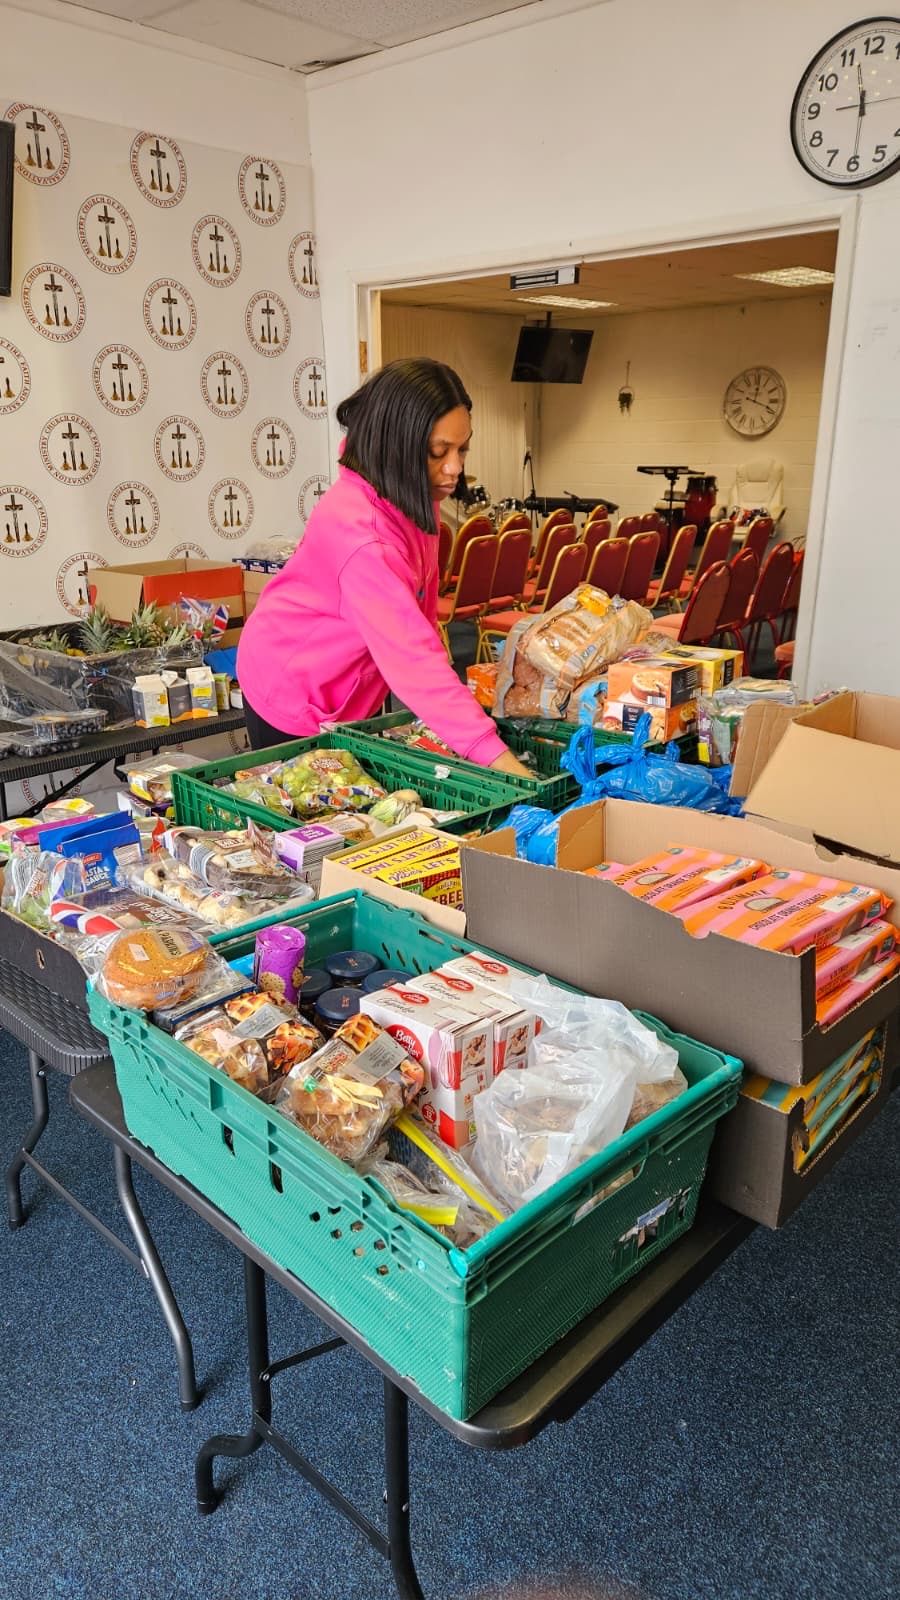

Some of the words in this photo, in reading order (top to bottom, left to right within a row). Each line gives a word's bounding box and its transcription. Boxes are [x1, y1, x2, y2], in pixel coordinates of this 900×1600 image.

[864, 36, 886, 56] 12
[841, 48, 856, 67] 11
[818, 73, 838, 92] 10
[808, 103, 820, 120] 9
[48, 112, 63, 129] FIRE
[61, 134, 69, 158] FAITH
[809, 131, 823, 147] 8
[826, 149, 839, 167] 7
[872, 145, 887, 162] 5
[59, 161, 68, 175] AND
[846, 155, 860, 172] 6
[17, 166, 60, 184] SALVATION
[26, 265, 51, 283] CHURCH
[64, 272, 79, 288] FIRE
[24, 288, 36, 323] MINISTRY
[77, 292, 85, 314] FAITH
[76, 317, 84, 330] AND
[36, 326, 77, 340] SALVATION
[46, 416, 69, 434] CHURCH
[81, 420, 95, 434] FIRE
[42, 438, 54, 471] MINISTRY
[92, 460, 100, 472] AND
[54, 472, 92, 484] SALVATION
[25, 491, 40, 504] FIRE
[38, 507, 47, 527] FAITH
[37, 531, 46, 543] AND
[423, 858, 456, 870] LET'S
[86, 874, 110, 886] SAUCE
[748, 913, 783, 931] CHOCOLATE
[776, 903, 803, 918] ORANGE
[797, 892, 828, 908] TEACAKES
[396, 1029, 416, 1046] Betty
